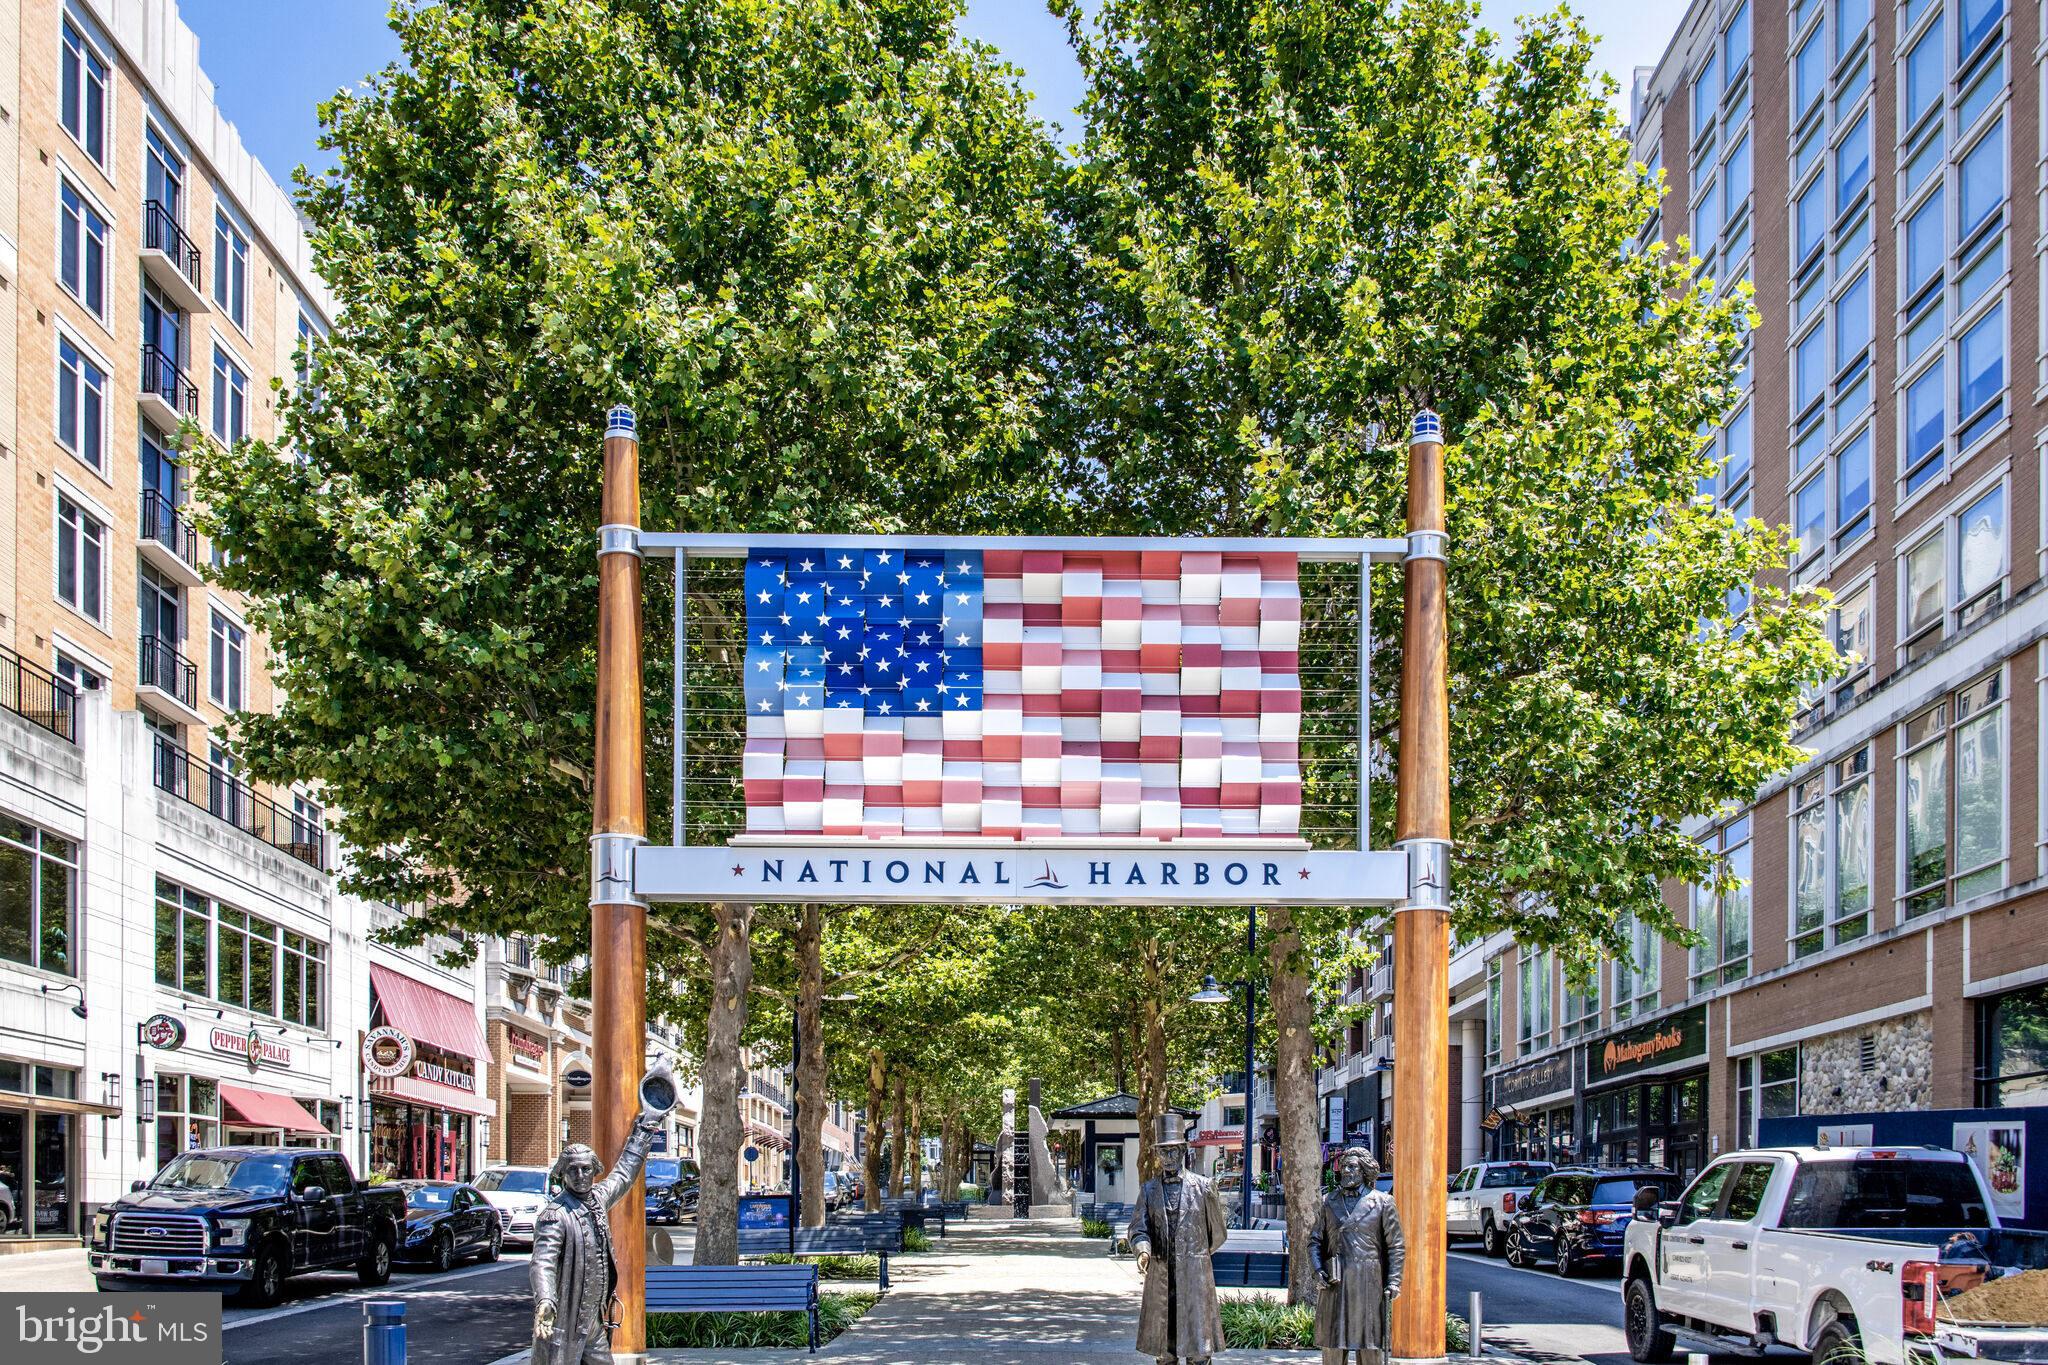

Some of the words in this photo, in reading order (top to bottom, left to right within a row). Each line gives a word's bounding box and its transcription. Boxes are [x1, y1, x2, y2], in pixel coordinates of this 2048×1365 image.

[761, 858, 1010, 885] NATIONAL
[1088, 861, 1283, 886] HARBOR
[213, 1030, 247, 1052] PEPPER
[262, 1042, 291, 1062] PALACE
[364, 1028, 410, 1051] SAVANNAH'S
[1616, 1026, 1682, 1063] MahoganyBooks
[365, 1053, 383, 1073] CANDY
[382, 1054, 409, 1074] KITCHEN
[416, 1060, 443, 1083] CANDY
[444, 1068, 476, 1092] KITCHEN
